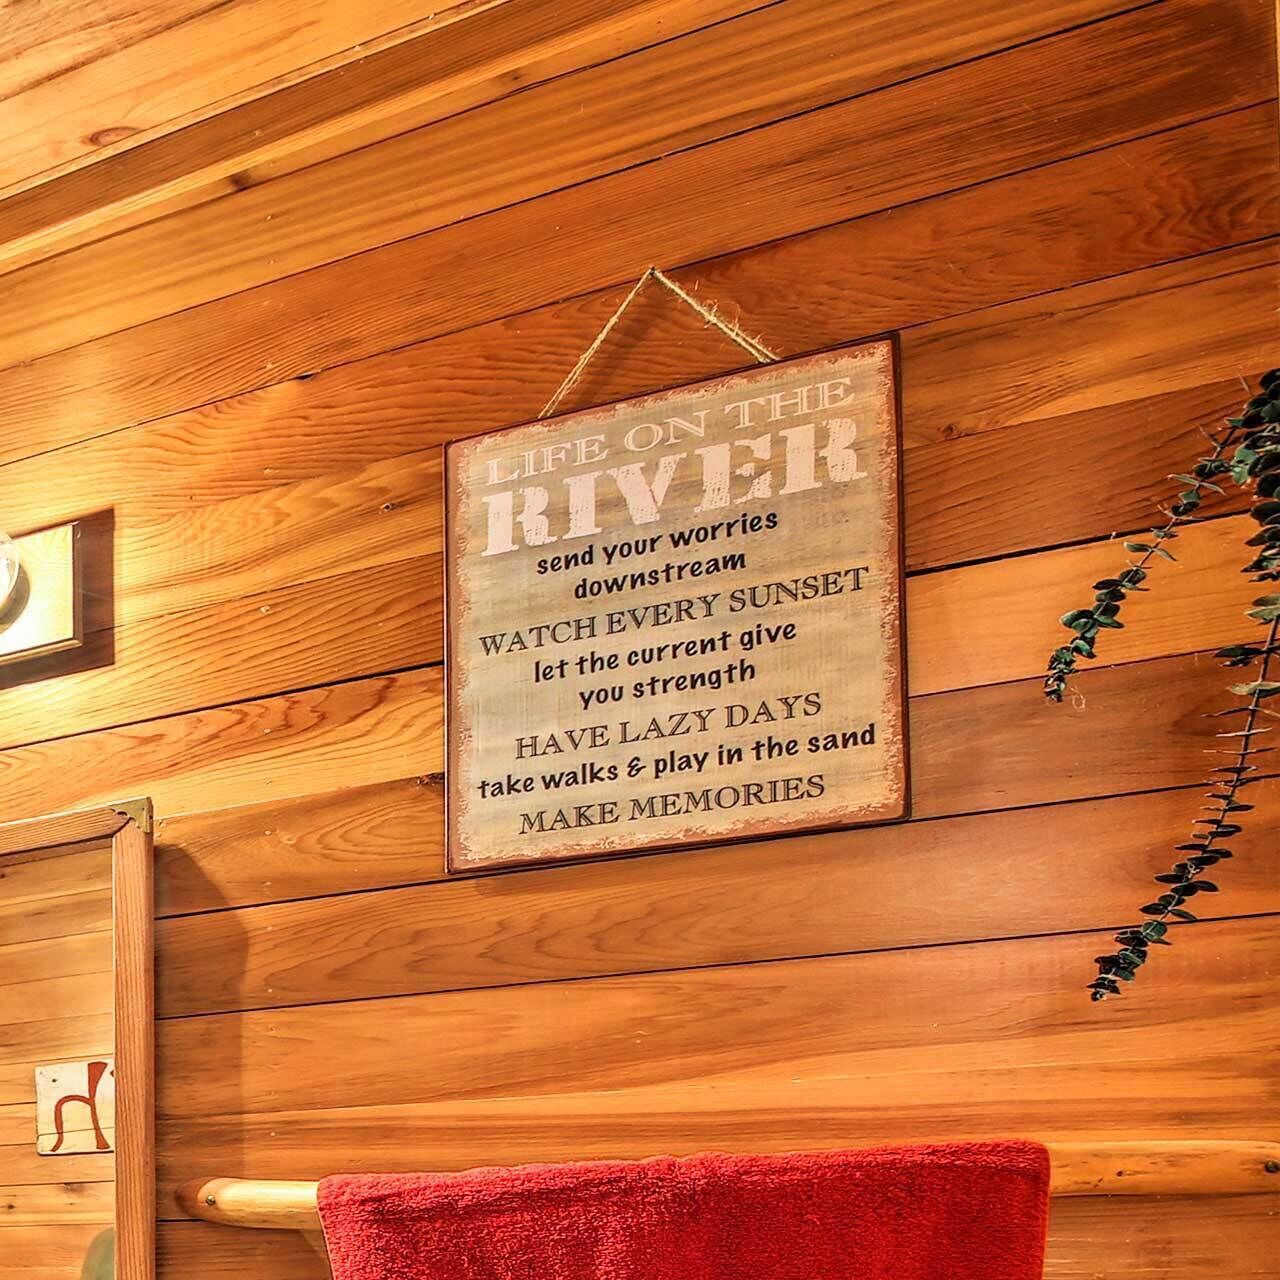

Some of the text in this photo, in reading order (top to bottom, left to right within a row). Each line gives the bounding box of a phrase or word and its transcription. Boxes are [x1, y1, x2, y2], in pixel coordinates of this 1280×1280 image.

[486, 377, 855, 486] LIFE ON THE
[481, 417, 868, 557] RIVER
[537, 512, 778, 575] send your worries
[574, 551, 746, 599] downstream
[479, 566, 869, 656] WATCH EVERY SUNSET
[535, 623, 796, 683] let the current give
[579, 658, 756, 711] you strength
[515, 692, 822, 760] HAVE LAZY DAYS
[477, 722, 876, 799] take walks & play in the sand
[518, 774, 825, 835] MAKE MEMORIES
